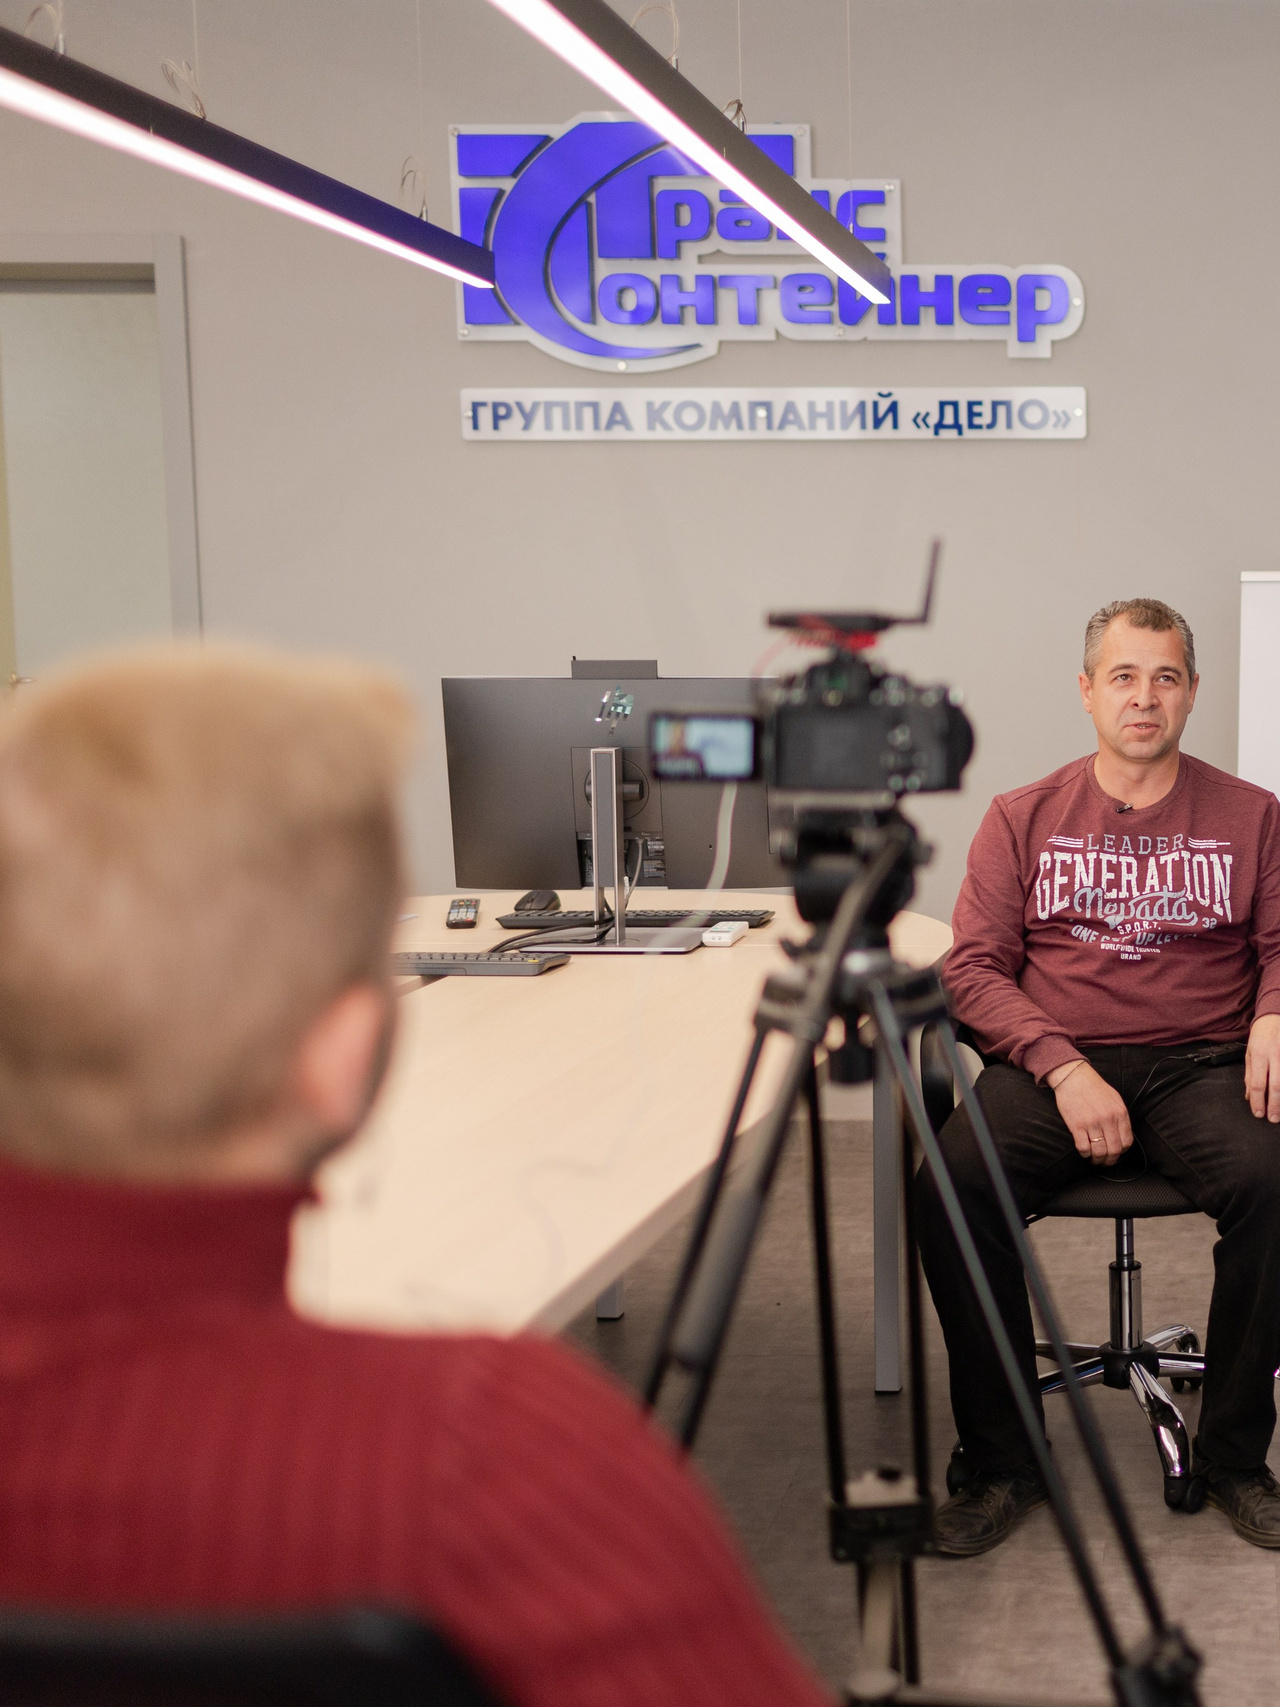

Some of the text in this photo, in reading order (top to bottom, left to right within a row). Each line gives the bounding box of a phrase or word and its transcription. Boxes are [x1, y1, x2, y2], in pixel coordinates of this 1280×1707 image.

[471, 392, 1072, 436] ГРУППА КОМПАНИЙ «ДЕЛО»
[1086, 833, 1184, 855] LEADER
[1035, 851, 1233, 923] GENERATION
[1202, 917, 1217, 929] 32
[1135, 932, 1155, 945] UP
